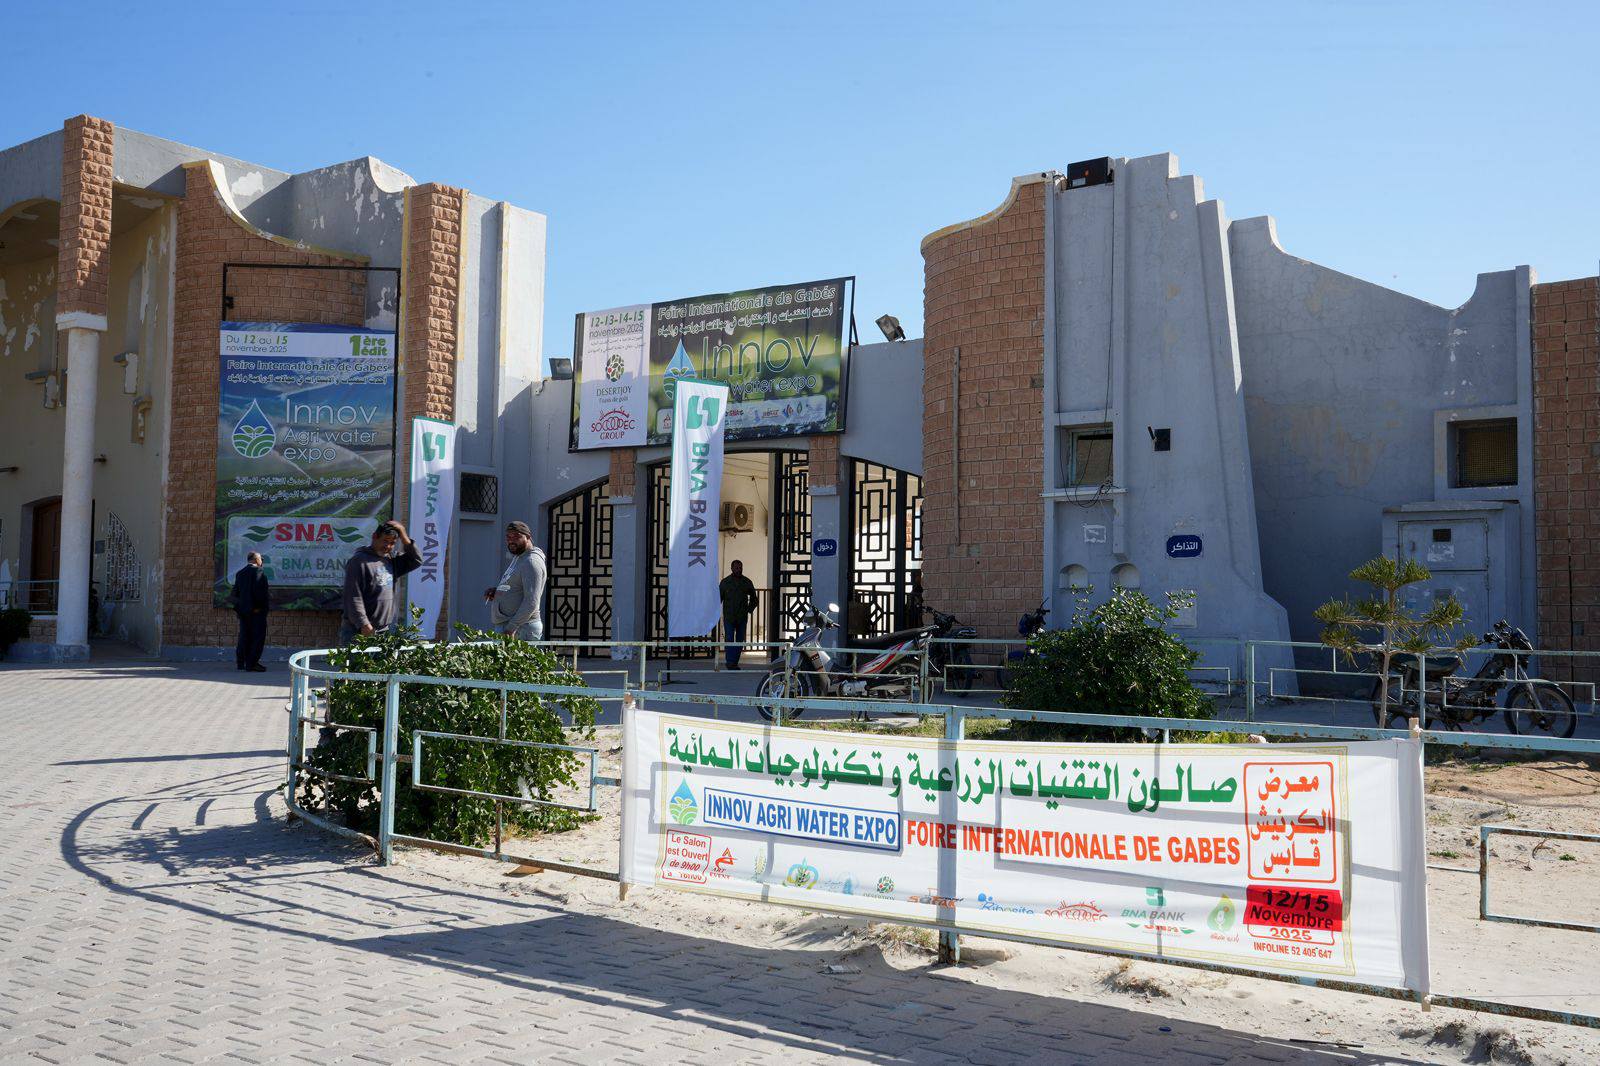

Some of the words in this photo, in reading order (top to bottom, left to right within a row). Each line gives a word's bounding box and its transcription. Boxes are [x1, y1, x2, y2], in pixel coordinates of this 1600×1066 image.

[658, 305, 687, 320] Foire
[688, 293, 773, 316] Internationale
[775, 291, 792, 306] de
[591, 311, 644, 328] 12-13-14-15
[226, 335, 240, 343] Du
[244, 334, 256, 344] 12
[276, 336, 288, 345] 15
[590, 327, 626, 338] novembre
[626, 323, 644, 334] 2025
[702, 334, 820, 378] Innov
[227, 360, 256, 370] Foire
[257, 360, 335, 372] Internationale
[338, 363, 352, 372] de
[596, 386, 632, 396] DESERTJOY
[730, 378, 773, 397] water
[778, 374, 816, 394] expo
[286, 398, 378, 424] Innov
[283, 428, 320, 446] Agri
[325, 430, 378, 443] water
[600, 431, 624, 440] GROUP
[283, 447, 336, 464] expo
[690, 442, 710, 494] BNA
[275, 523, 334, 542] SNA
[688, 500, 706, 568] BANK
[421, 522, 440, 584] BANK
[817, 542, 833, 552] دخول
[1171, 542, 1198, 553] التذاكر
[282, 558, 312, 570] BNA
[316, 558, 347, 570] BAN
[668, 728, 740, 773] المائية
[907, 752, 1003, 804] الزراعية
[1010, 758, 1120, 810] التقنيات
[1258, 767, 1320, 801] معرض
[708, 794, 752, 824] INNOV
[756, 804, 791, 829] AGRI
[796, 807, 849, 836] WATER
[854, 815, 896, 844] EXPO
[1251, 804, 1332, 841] الكرنيش
[672, 834, 681, 844] Le
[684, 836, 706, 848] Salon
[907, 820, 957, 850] FOIRE
[963, 825, 1128, 860] INTERNATIONALE
[1134, 835, 1162, 862] DE
[1168, 836, 1241, 865] GABES
[668, 848, 680, 856] est
[682, 848, 708, 860] Ouvert
[1264, 838, 1320, 874] قابس
[681, 861, 700, 871] 9h00
[1263, 888, 1329, 912] 12/15
[1120, 908, 1147, 919] BNA
[1148, 910, 1185, 921] BANK
[1250, 905, 1334, 928] Novembre
[1270, 928, 1312, 941] 2025
[1254, 942, 1289, 954] INFOLINE
[1292, 946, 1300, 956] 52
[1302, 947, 1316, 957] 405
[1318, 949, 1332, 959] 647
